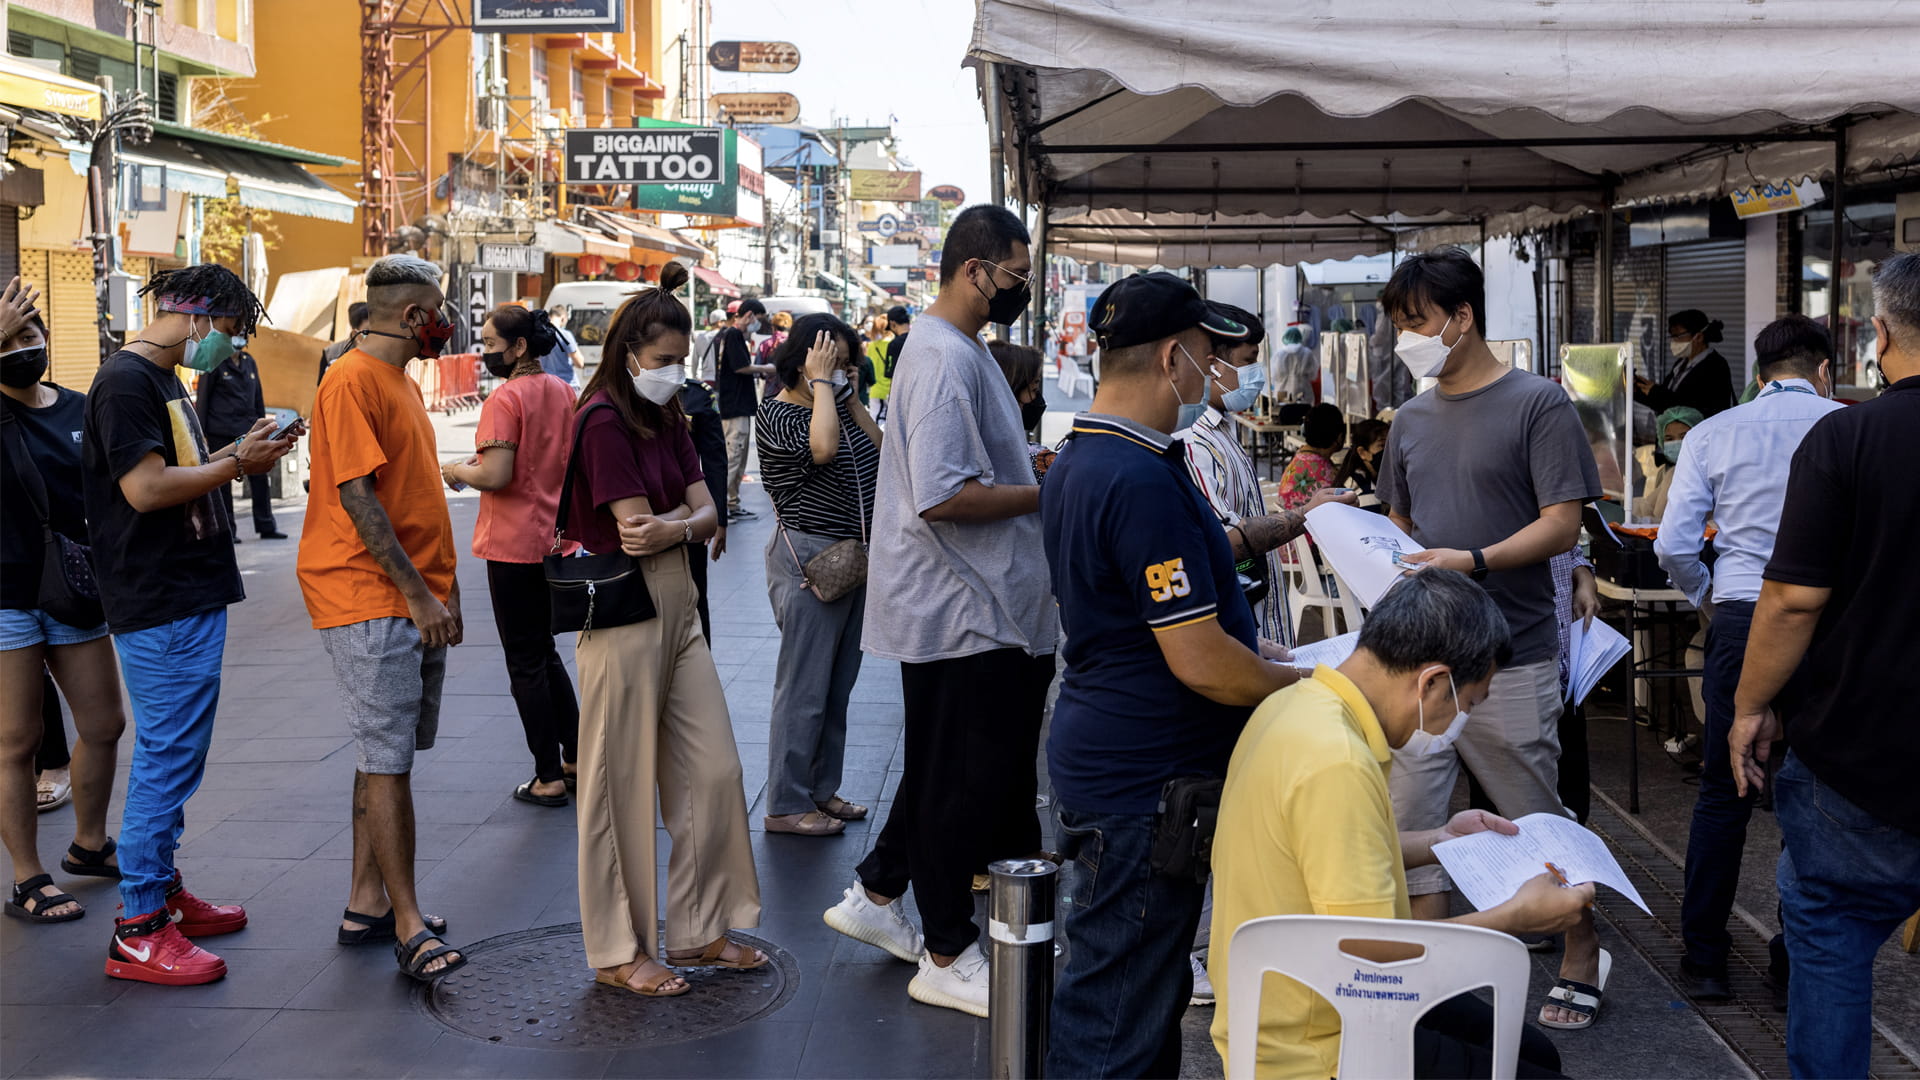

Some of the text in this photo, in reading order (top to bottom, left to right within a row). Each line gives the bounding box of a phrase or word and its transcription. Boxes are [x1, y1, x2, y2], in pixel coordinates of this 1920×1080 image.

[593, 135, 692, 153] BIGGAINK
[574, 154, 713, 180] TATTOO
[1144, 557, 1192, 603] 95
